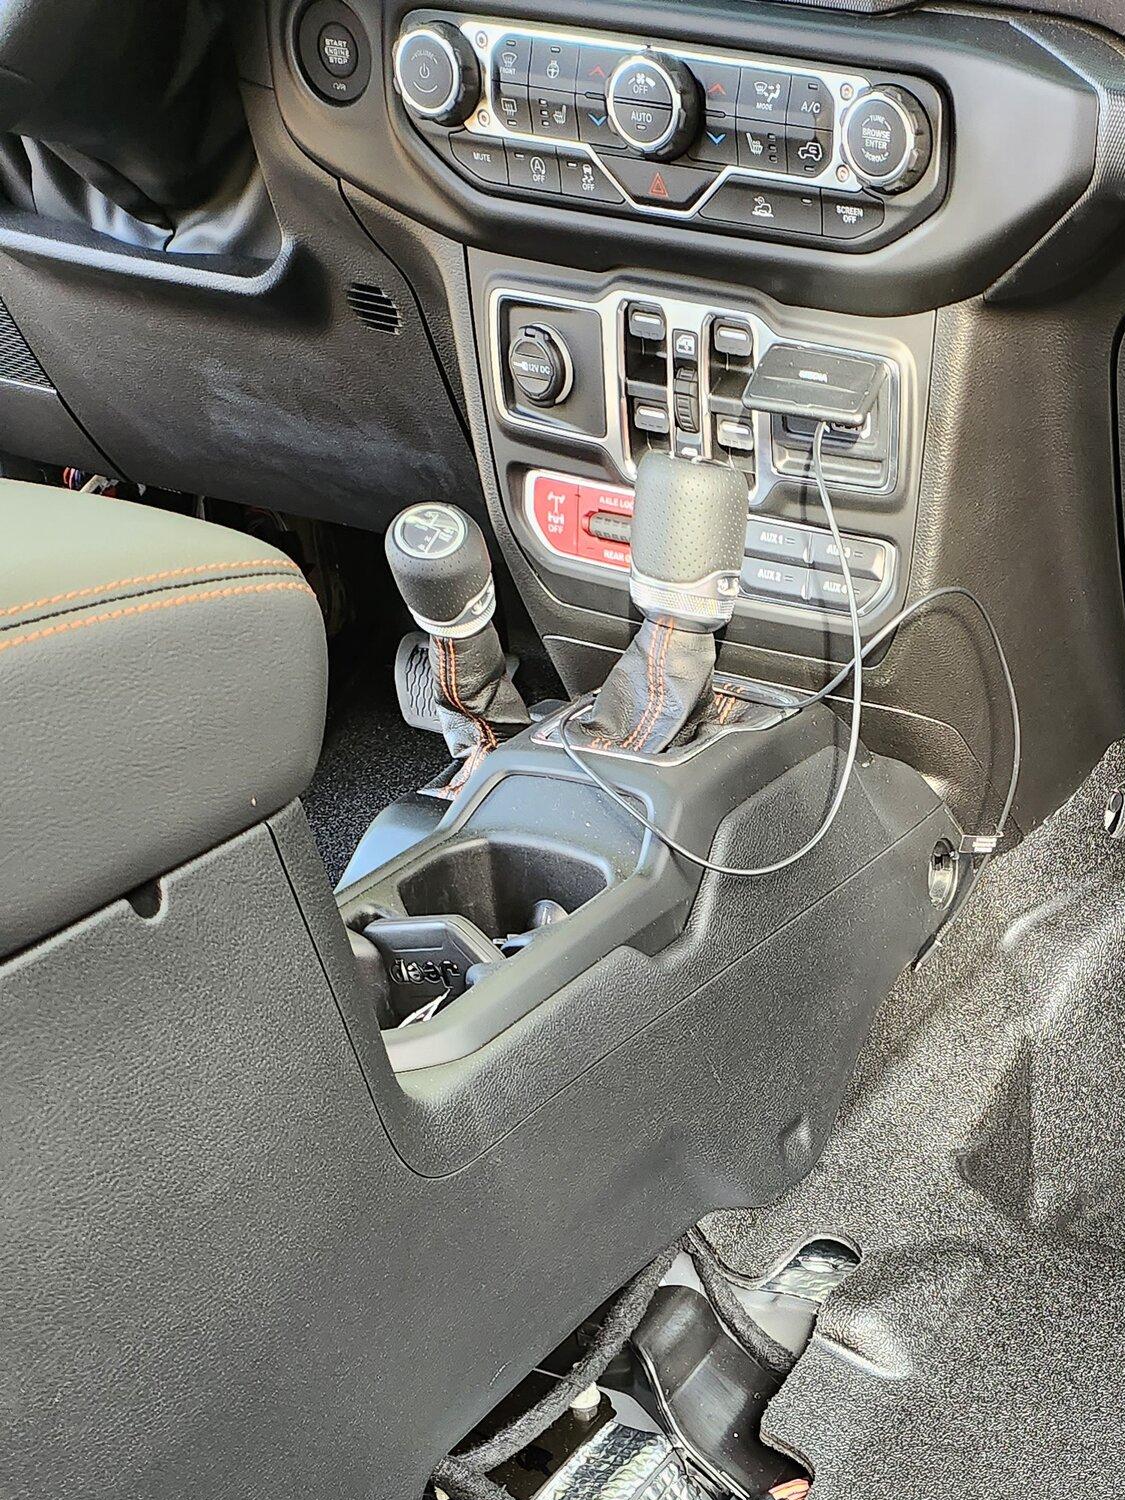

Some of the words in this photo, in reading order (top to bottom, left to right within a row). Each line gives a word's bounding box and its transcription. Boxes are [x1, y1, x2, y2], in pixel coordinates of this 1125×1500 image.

[325, 38, 347, 47] START
[413, 49, 435, 60] VOLUME
[329, 57, 348, 65] STOP
[500, 66, 517, 75] FRONT
[633, 85, 648, 94] OFF
[756, 102, 773, 111] MODE
[801, 101, 821, 114] A/C
[631, 110, 653, 123] AUTO
[869, 114, 885, 124] TUNE
[862, 128, 891, 140] BROWSE
[865, 139, 888, 150] ENTER
[532, 173, 546, 182] OFF
[581, 183, 595, 191] OFF
[836, 205, 864, 217] SCREEN
[842, 214, 857, 224] OFF
[528, 363, 539, 373] 12V
[539, 365, 551, 375] DC
[547, 523, 564, 534] OFF
[760, 531, 778, 544] AUX
[603, 549, 624, 560] REAR
[757, 568, 775, 581] AUX
[822, 581, 840, 593] AUX
